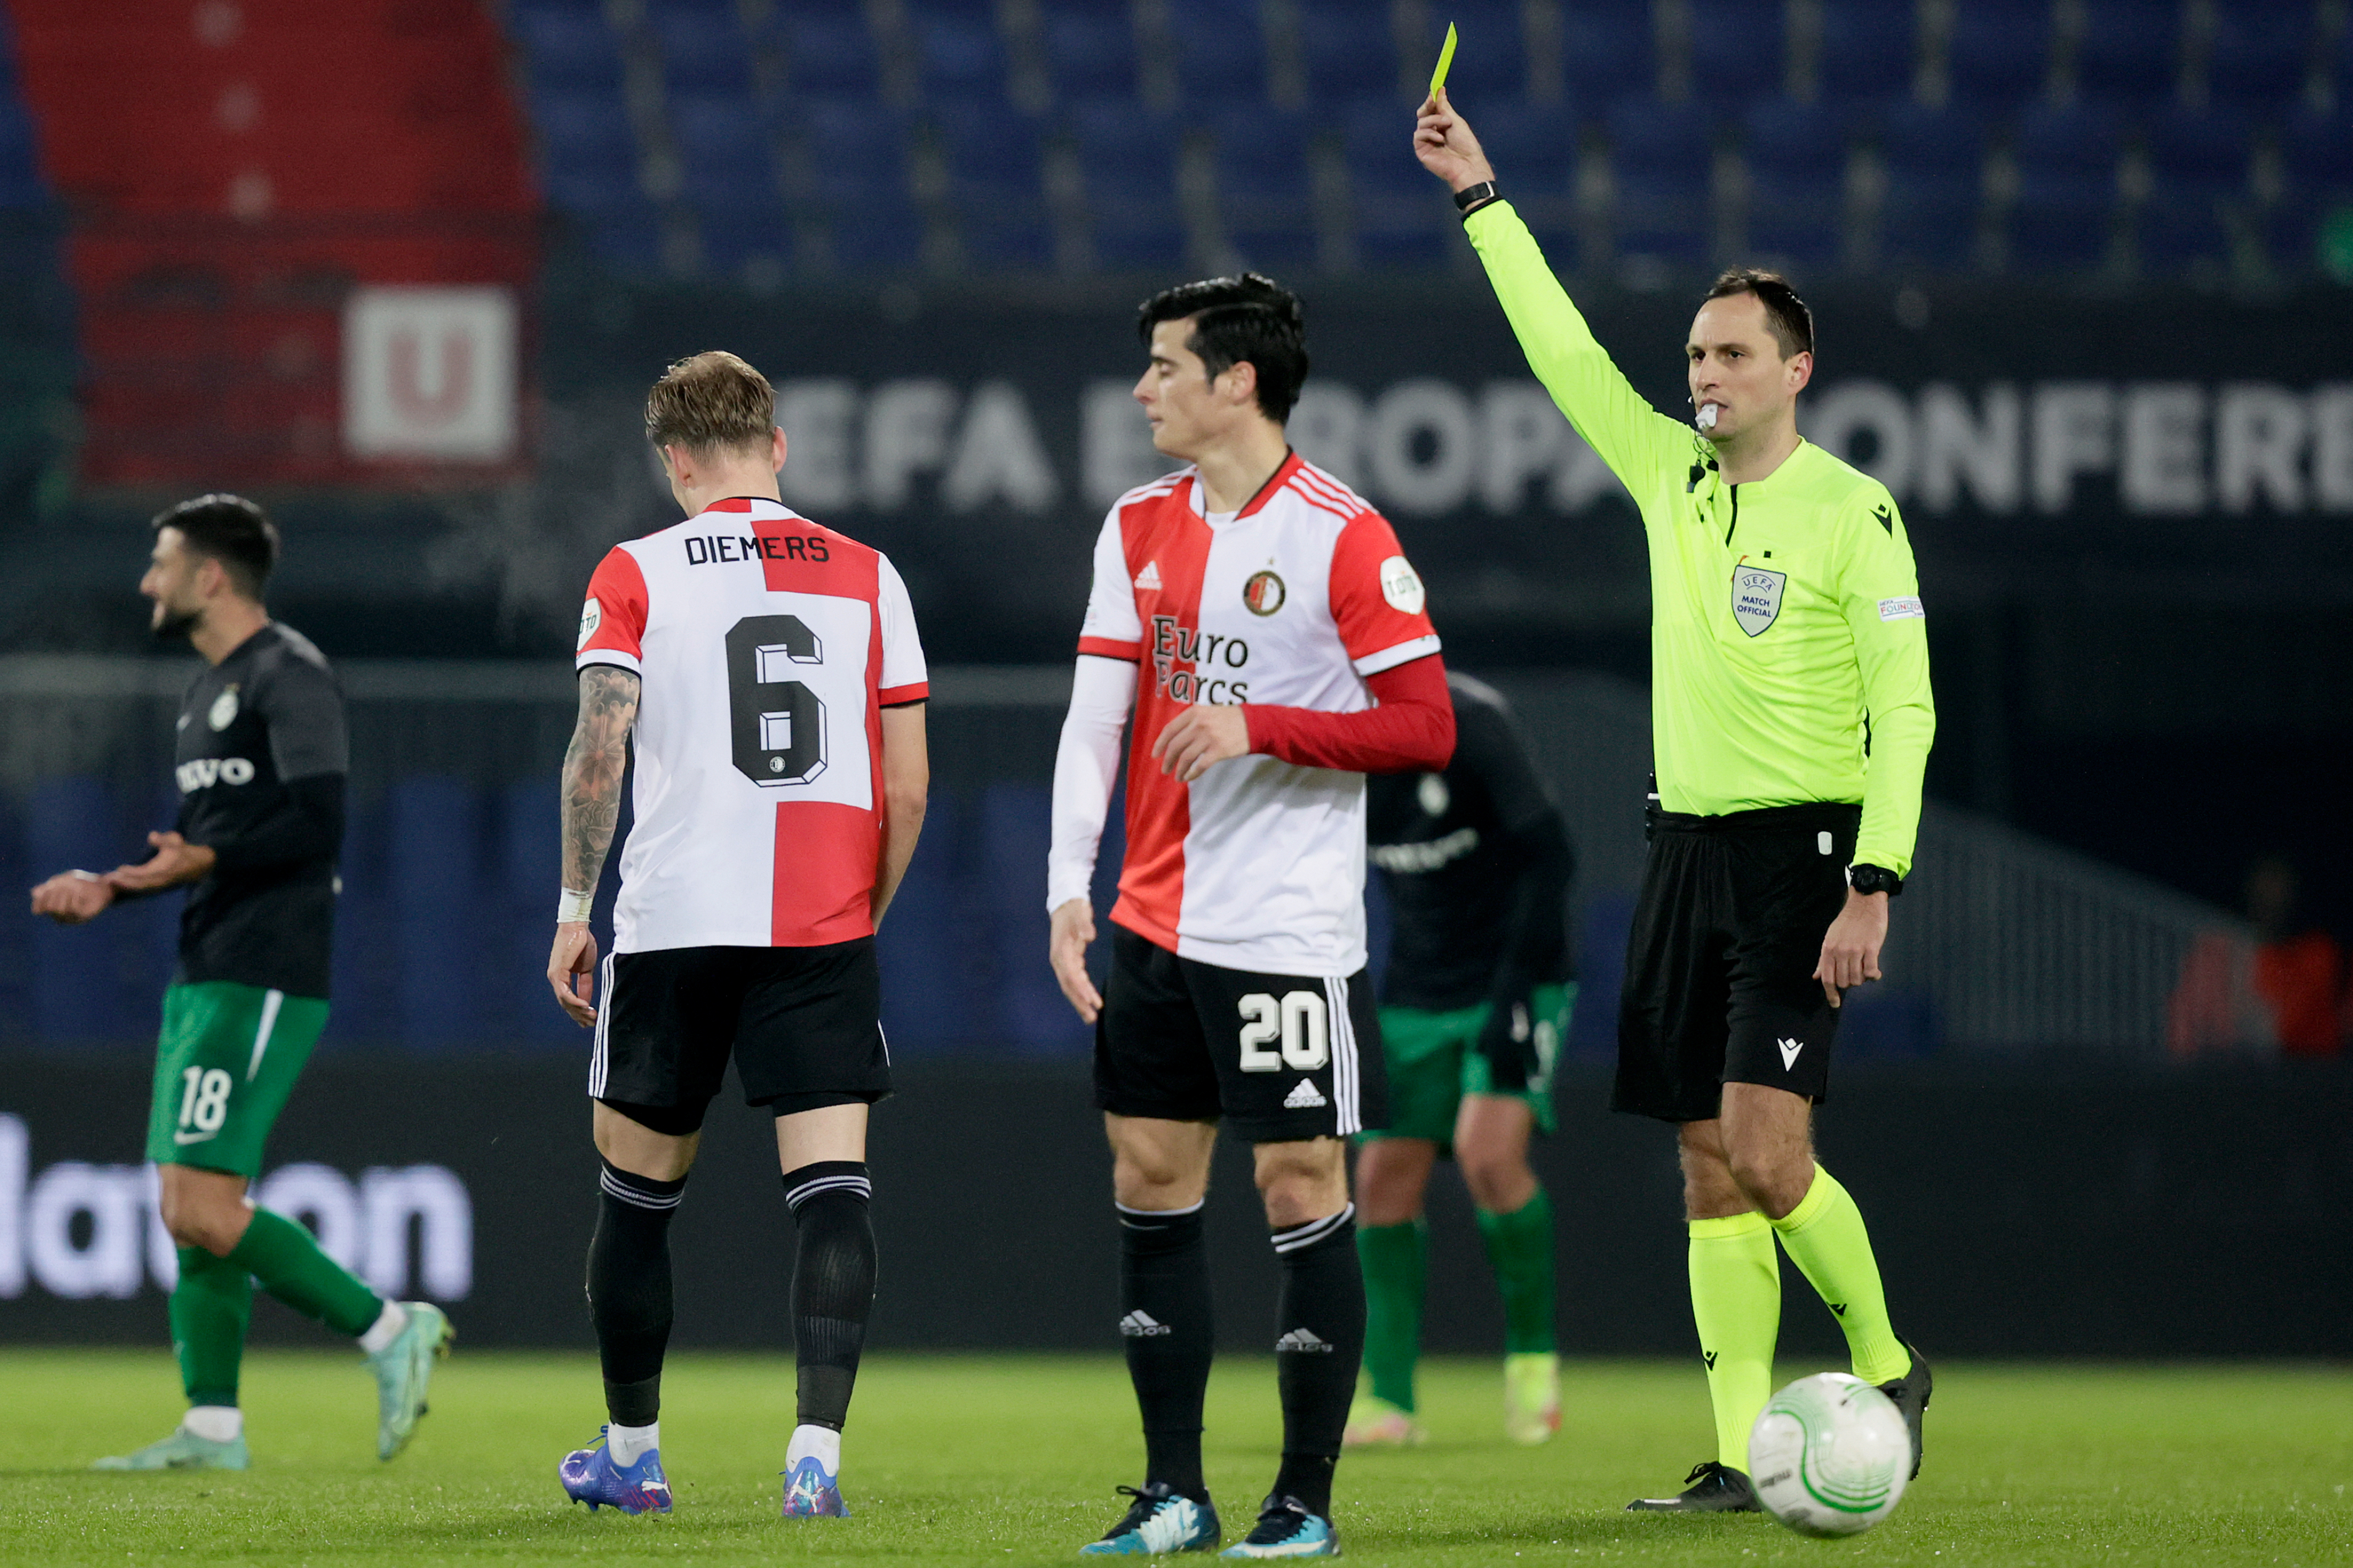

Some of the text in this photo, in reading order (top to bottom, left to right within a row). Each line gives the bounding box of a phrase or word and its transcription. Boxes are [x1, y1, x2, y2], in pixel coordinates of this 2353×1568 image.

[387, 330, 474, 426] U
[775, 379, 1059, 514] EFA
[685, 536, 830, 565] DIEMERS
[1741, 595, 1770, 607] MATCH
[1743, 576, 1772, 591] UEFA
[1737, 605, 1771, 618] OFFICIAL
[1153, 616, 1248, 668] Euro
[725, 614, 827, 787] 6
[1154, 659, 1248, 705] Parcs
[1237, 991, 1328, 1072] 20
[179, 1065, 232, 1131] 18
